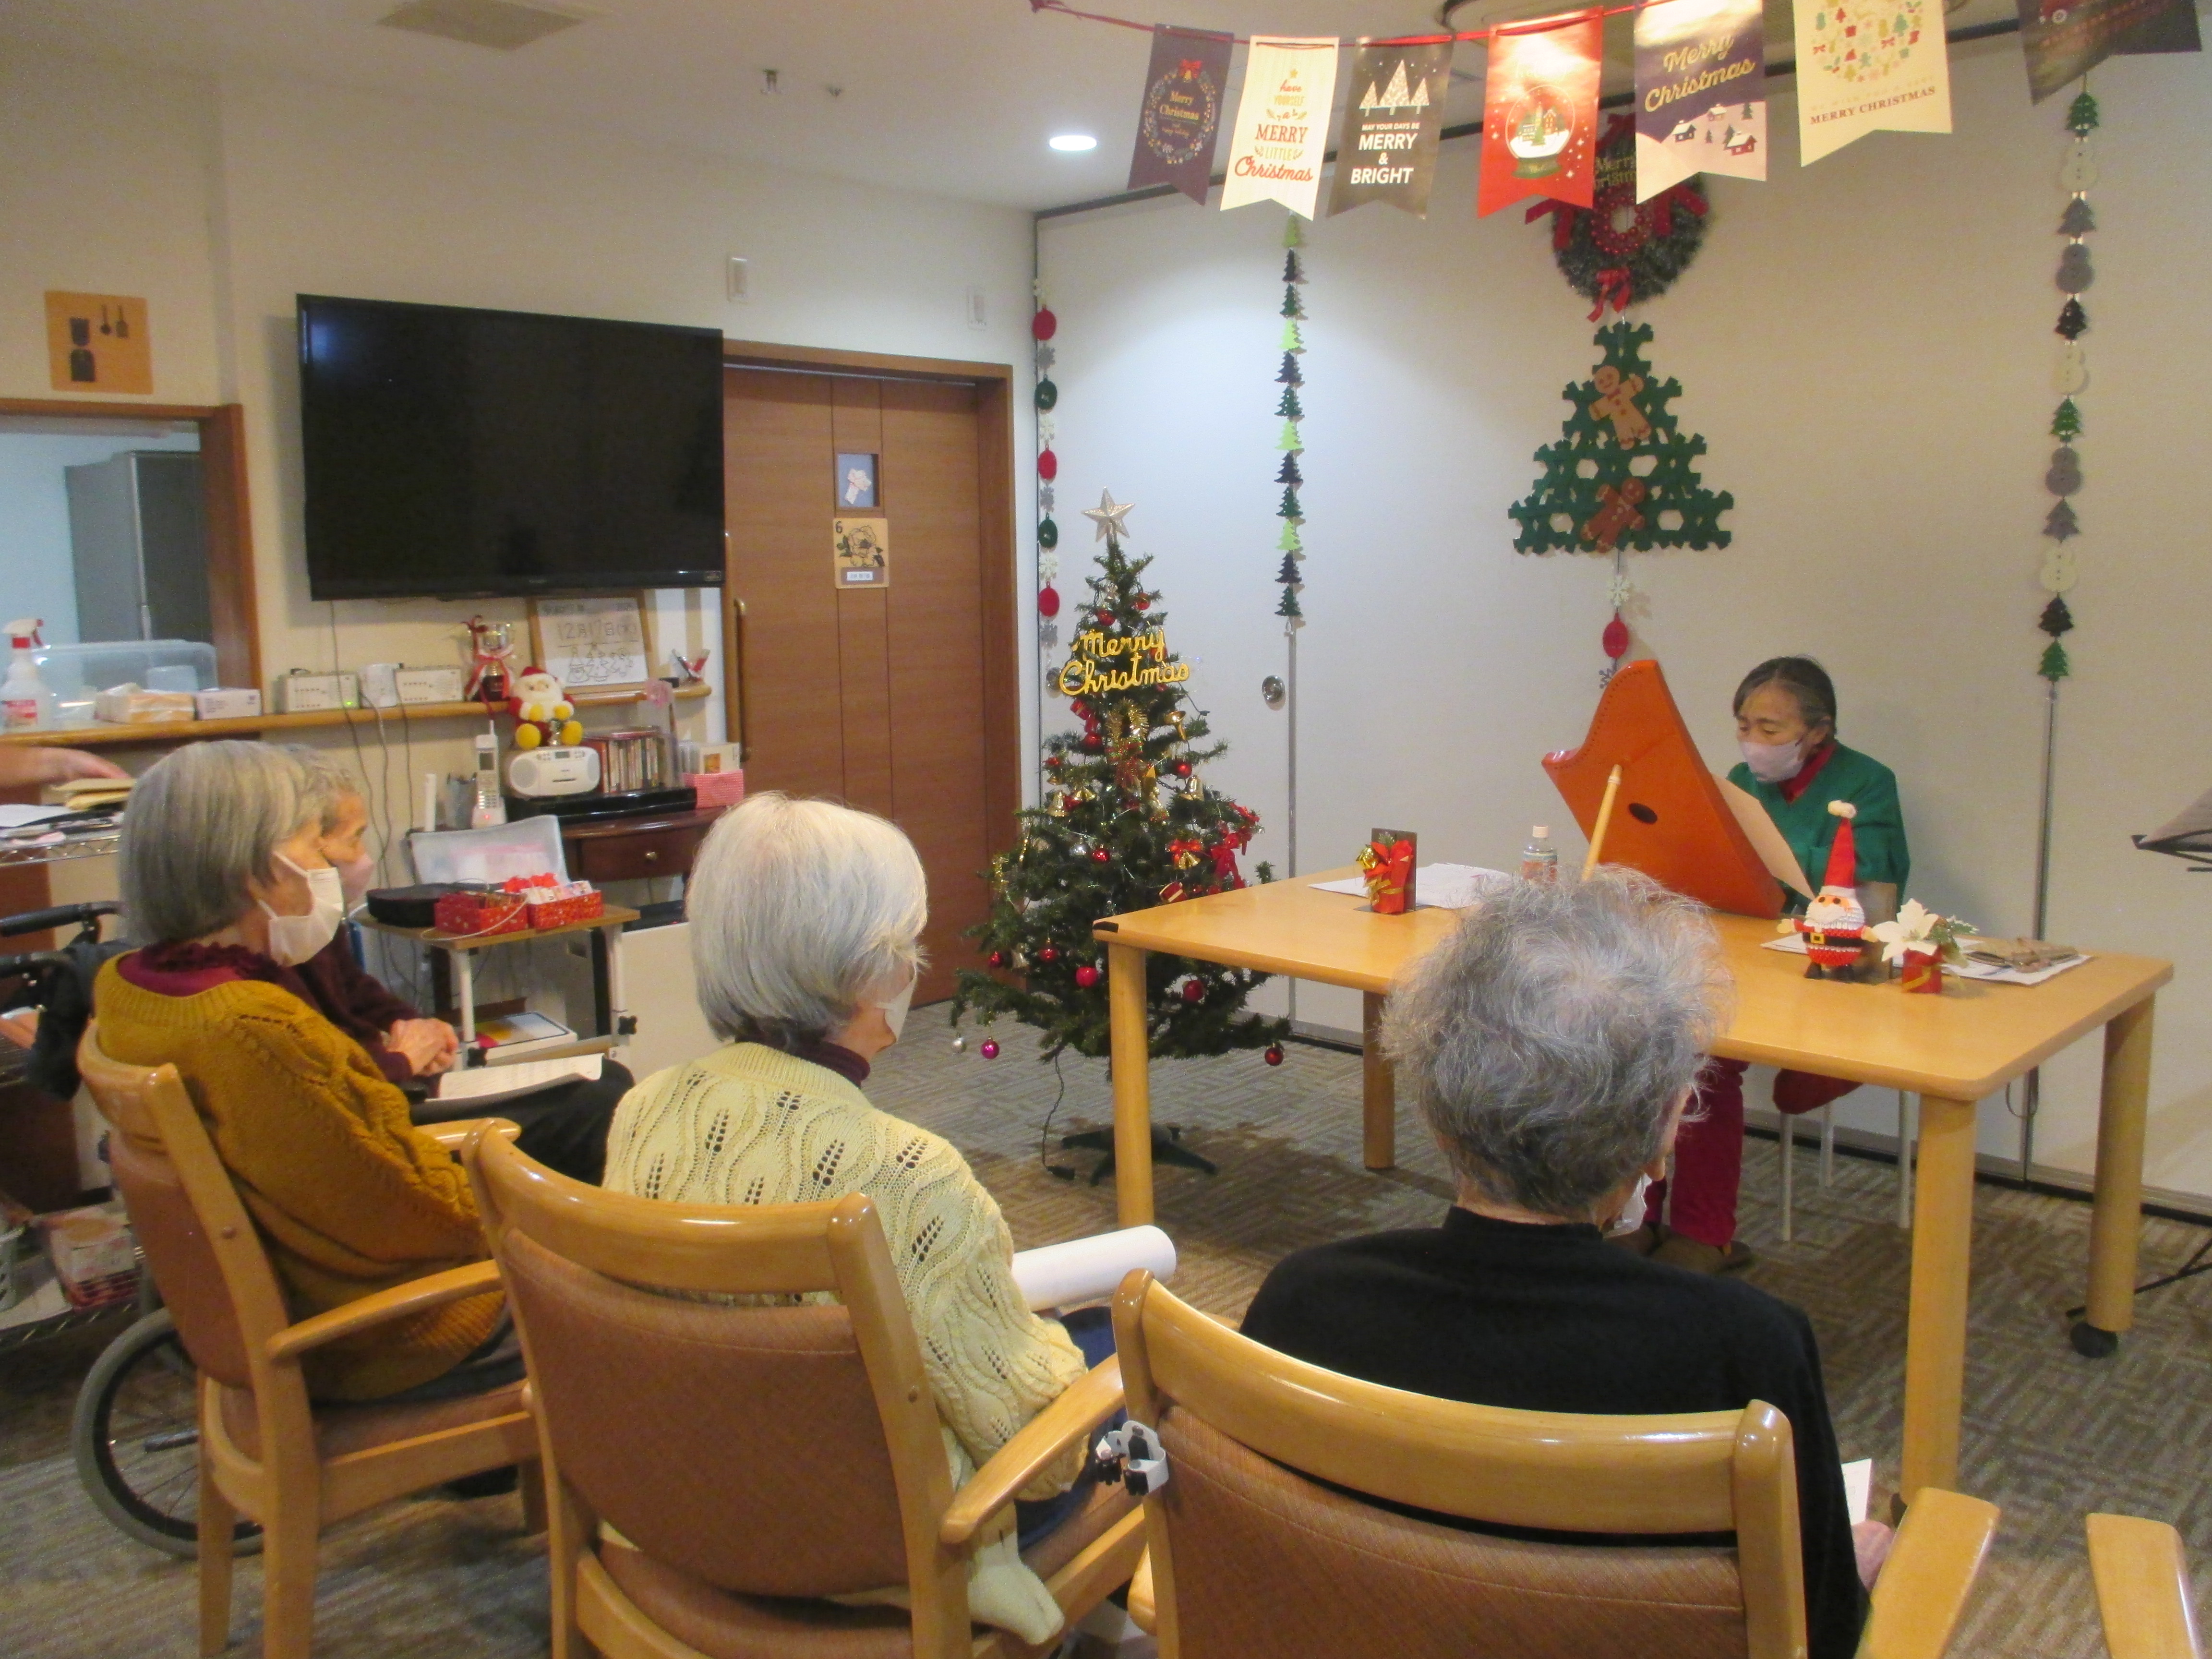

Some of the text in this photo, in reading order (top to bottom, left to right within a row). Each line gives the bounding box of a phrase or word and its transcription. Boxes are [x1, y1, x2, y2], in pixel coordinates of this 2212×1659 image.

[1663, 35, 1734, 72] Merry
[1280, 79, 1302, 92] have
[1645, 58, 1756, 112] Christmas
[1809, 107, 1854, 124] MERRY
[1859, 86, 1936, 113] CHRISTMAS
[1255, 123, 1308, 144] MERRY
[1358, 132, 1418, 150] MERRY
[1265, 147, 1292, 161] LITTLE
[1378, 152, 1389, 165] &
[1235, 155, 1313, 181] Christmas
[1350, 167, 1414, 184] BRIGHT
[835, 520, 843, 533] 6
[1070, 627, 1166, 662] Merry
[1059, 652, 1190, 696] Christmas
